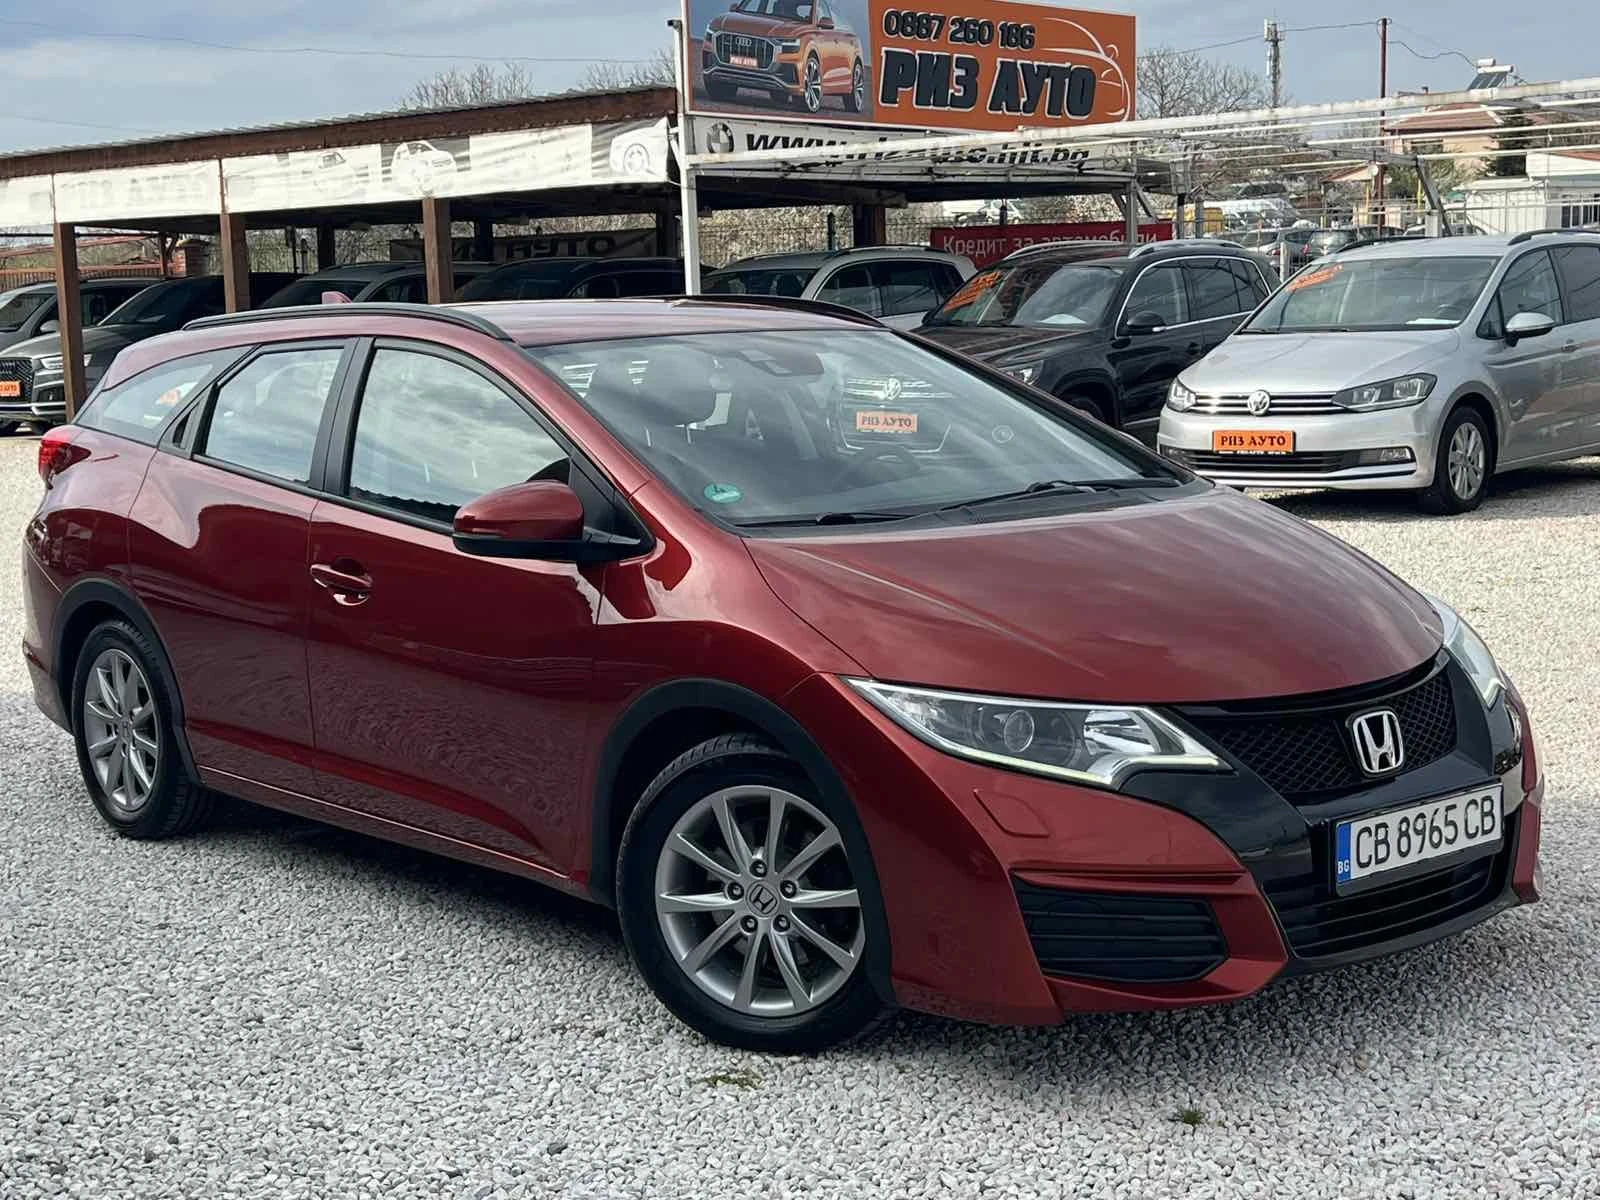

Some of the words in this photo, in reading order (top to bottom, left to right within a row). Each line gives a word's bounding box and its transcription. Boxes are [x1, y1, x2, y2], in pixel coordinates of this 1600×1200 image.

[884, 9, 946, 42] 0887
[948, 16, 995, 47] 260
[879, 47, 979, 111] РИЗ
[987, 57, 1097, 119] АУТО
[943, 235, 1007, 258] Кредит
[881, 416, 912, 428] АУТО
[1220, 435, 1245, 447] РИЗ
[1247, 435, 1287, 447] АУТО
[1356, 822, 1391, 869] CB
[1396, 804, 1459, 858] 8965
[1464, 795, 1496, 839] CB
[1337, 860, 1350, 874] BG
